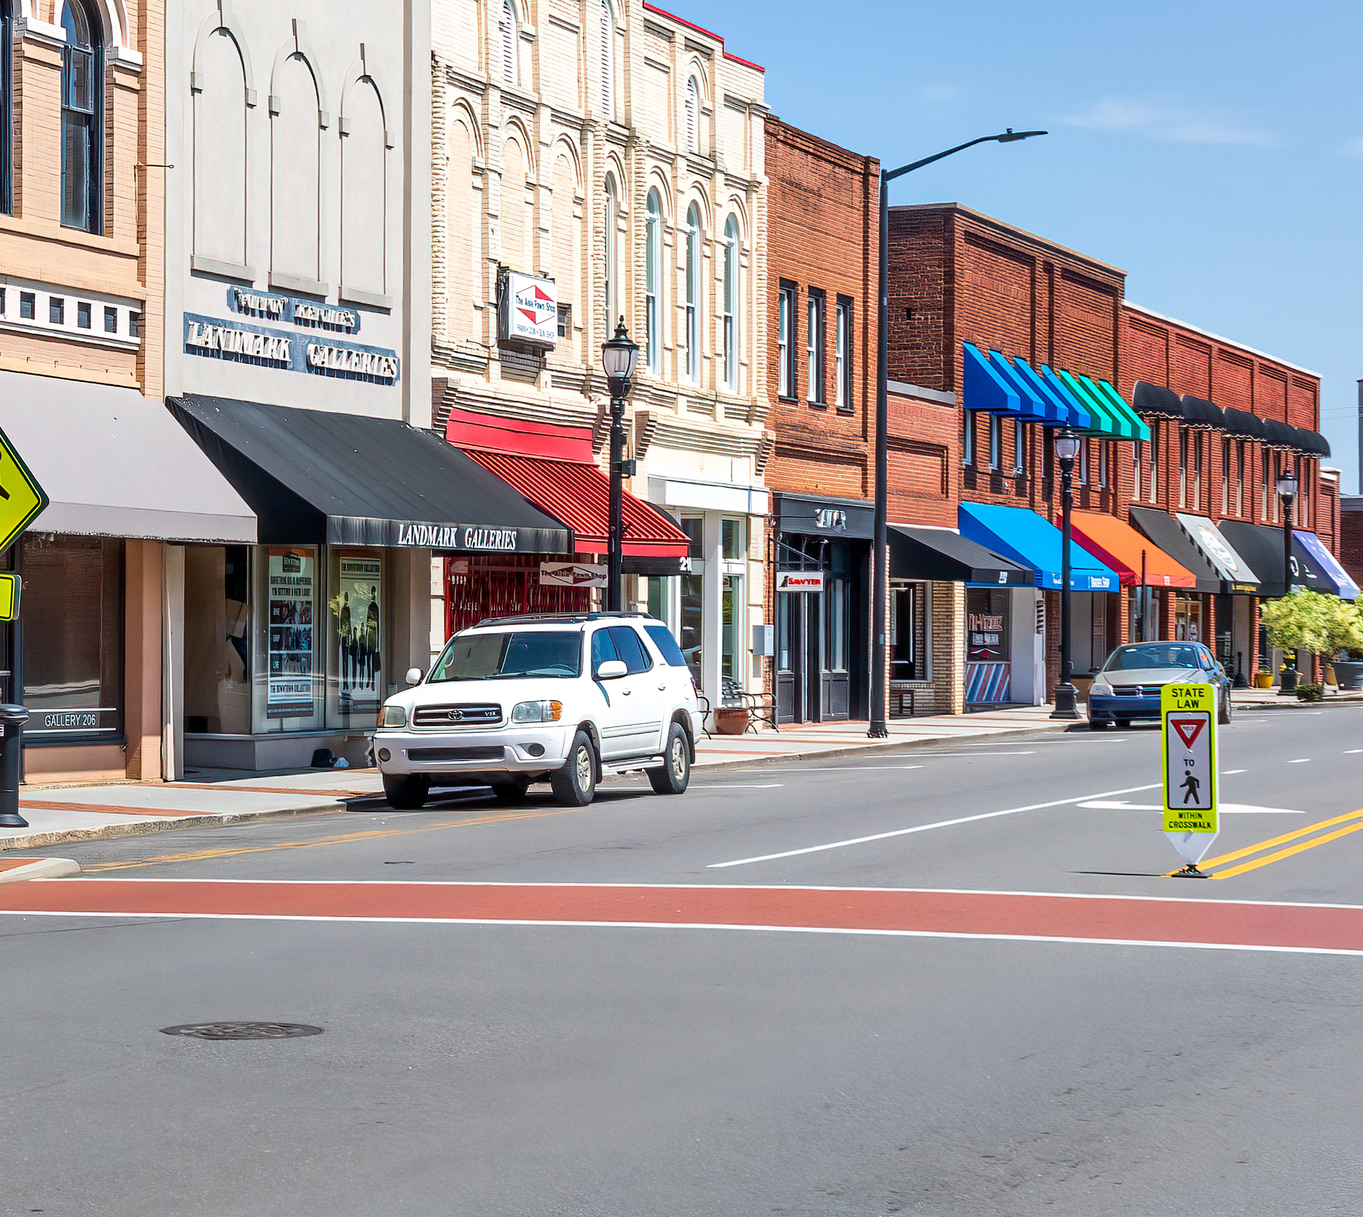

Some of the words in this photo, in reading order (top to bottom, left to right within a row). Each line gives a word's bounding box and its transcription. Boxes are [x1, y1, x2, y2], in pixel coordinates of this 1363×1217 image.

[186, 319, 293, 362] LANDMARK
[306, 342, 398, 379] GALLERIES
[397, 523, 458, 548] LANDMARK
[464, 527, 517, 550] GALLERIES
[541, 569, 554, 577] The
[554, 569, 570, 578] Aisle
[572, 571, 590, 579] Pawn
[591, 572, 607, 580] Shop
[788, 577, 821, 586] SAWYER
[1171, 687, 1206, 698] STATE
[1177, 699, 1200, 709] LAW
[44, 714, 81, 727] GALLERY
[82, 714, 96, 726] 206
[1183, 758, 1195, 767] TO
[1168, 821, 1212, 829] CROSSWALK
